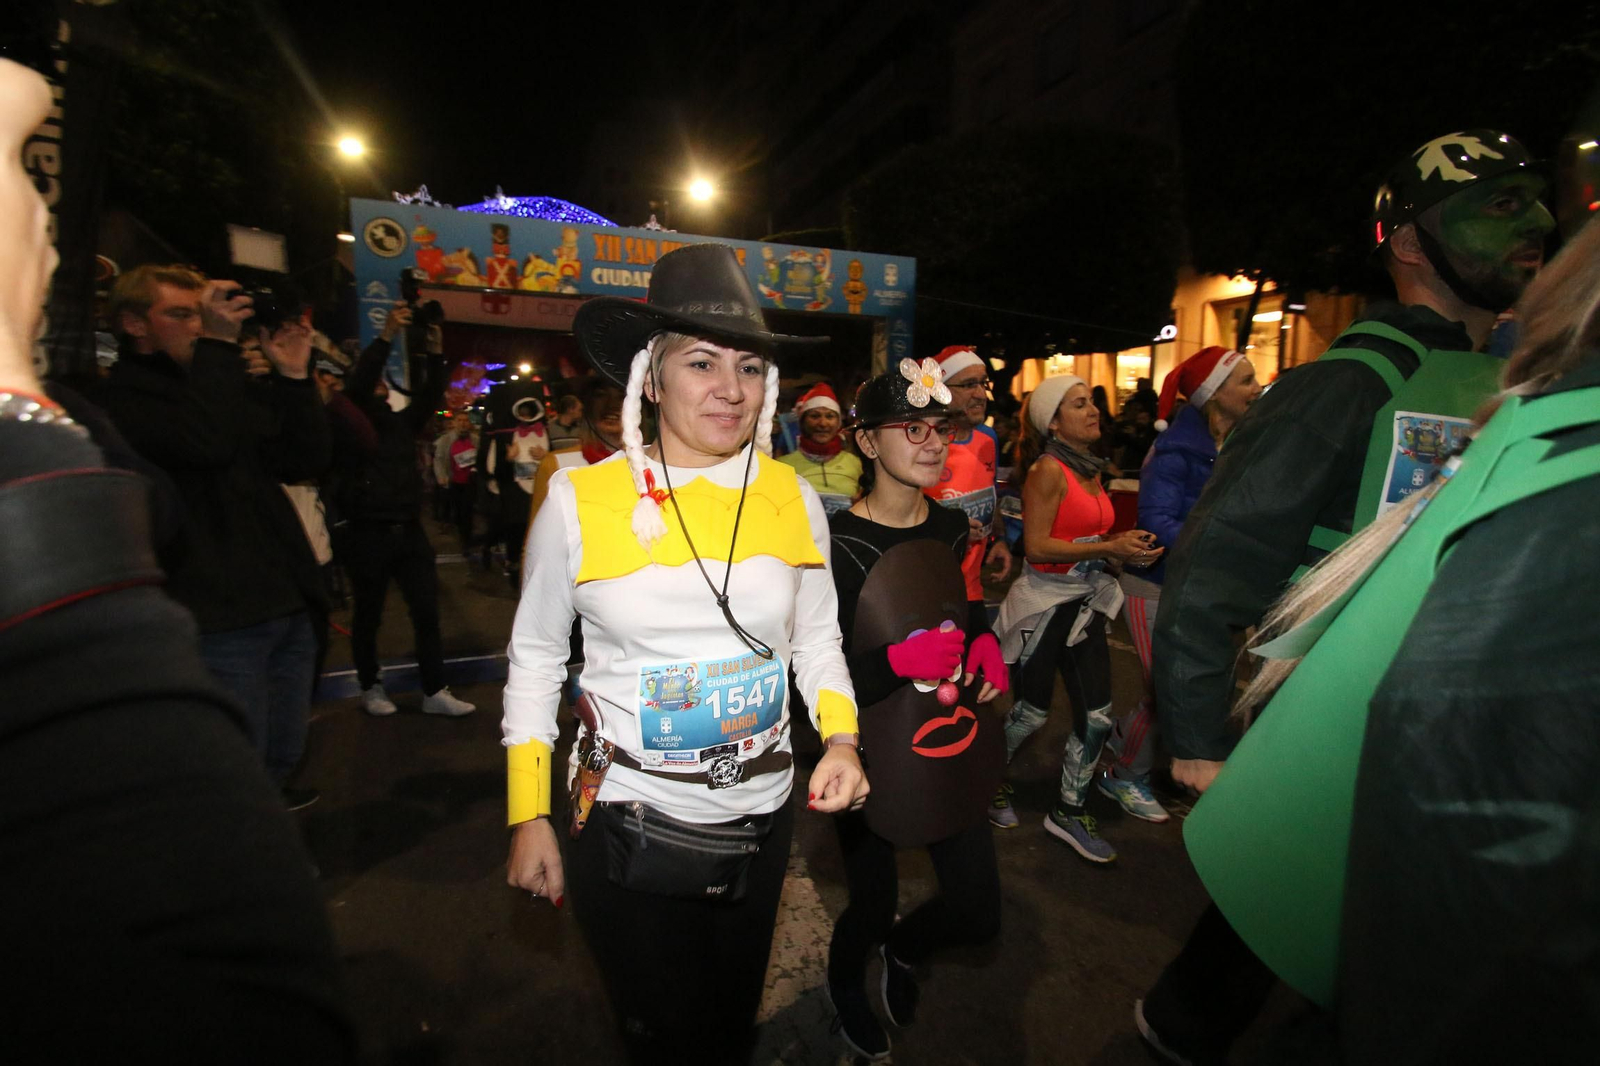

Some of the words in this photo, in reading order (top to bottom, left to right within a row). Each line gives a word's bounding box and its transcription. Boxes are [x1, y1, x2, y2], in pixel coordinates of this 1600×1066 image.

[593, 233, 622, 262] XII
[625, 237, 657, 265] SAN
[706, 663, 720, 678] XII
[722, 659, 740, 676] SAN
[742, 654, 777, 671] SILVES
[707, 676, 739, 688] CIUDAD
[741, 673, 751, 682] DE
[752, 662, 780, 679] ALMERÍA
[705, 673, 780, 719] 1547
[721, 711, 758, 735] MARGA
[652, 735, 683, 743] ALMERÍA
